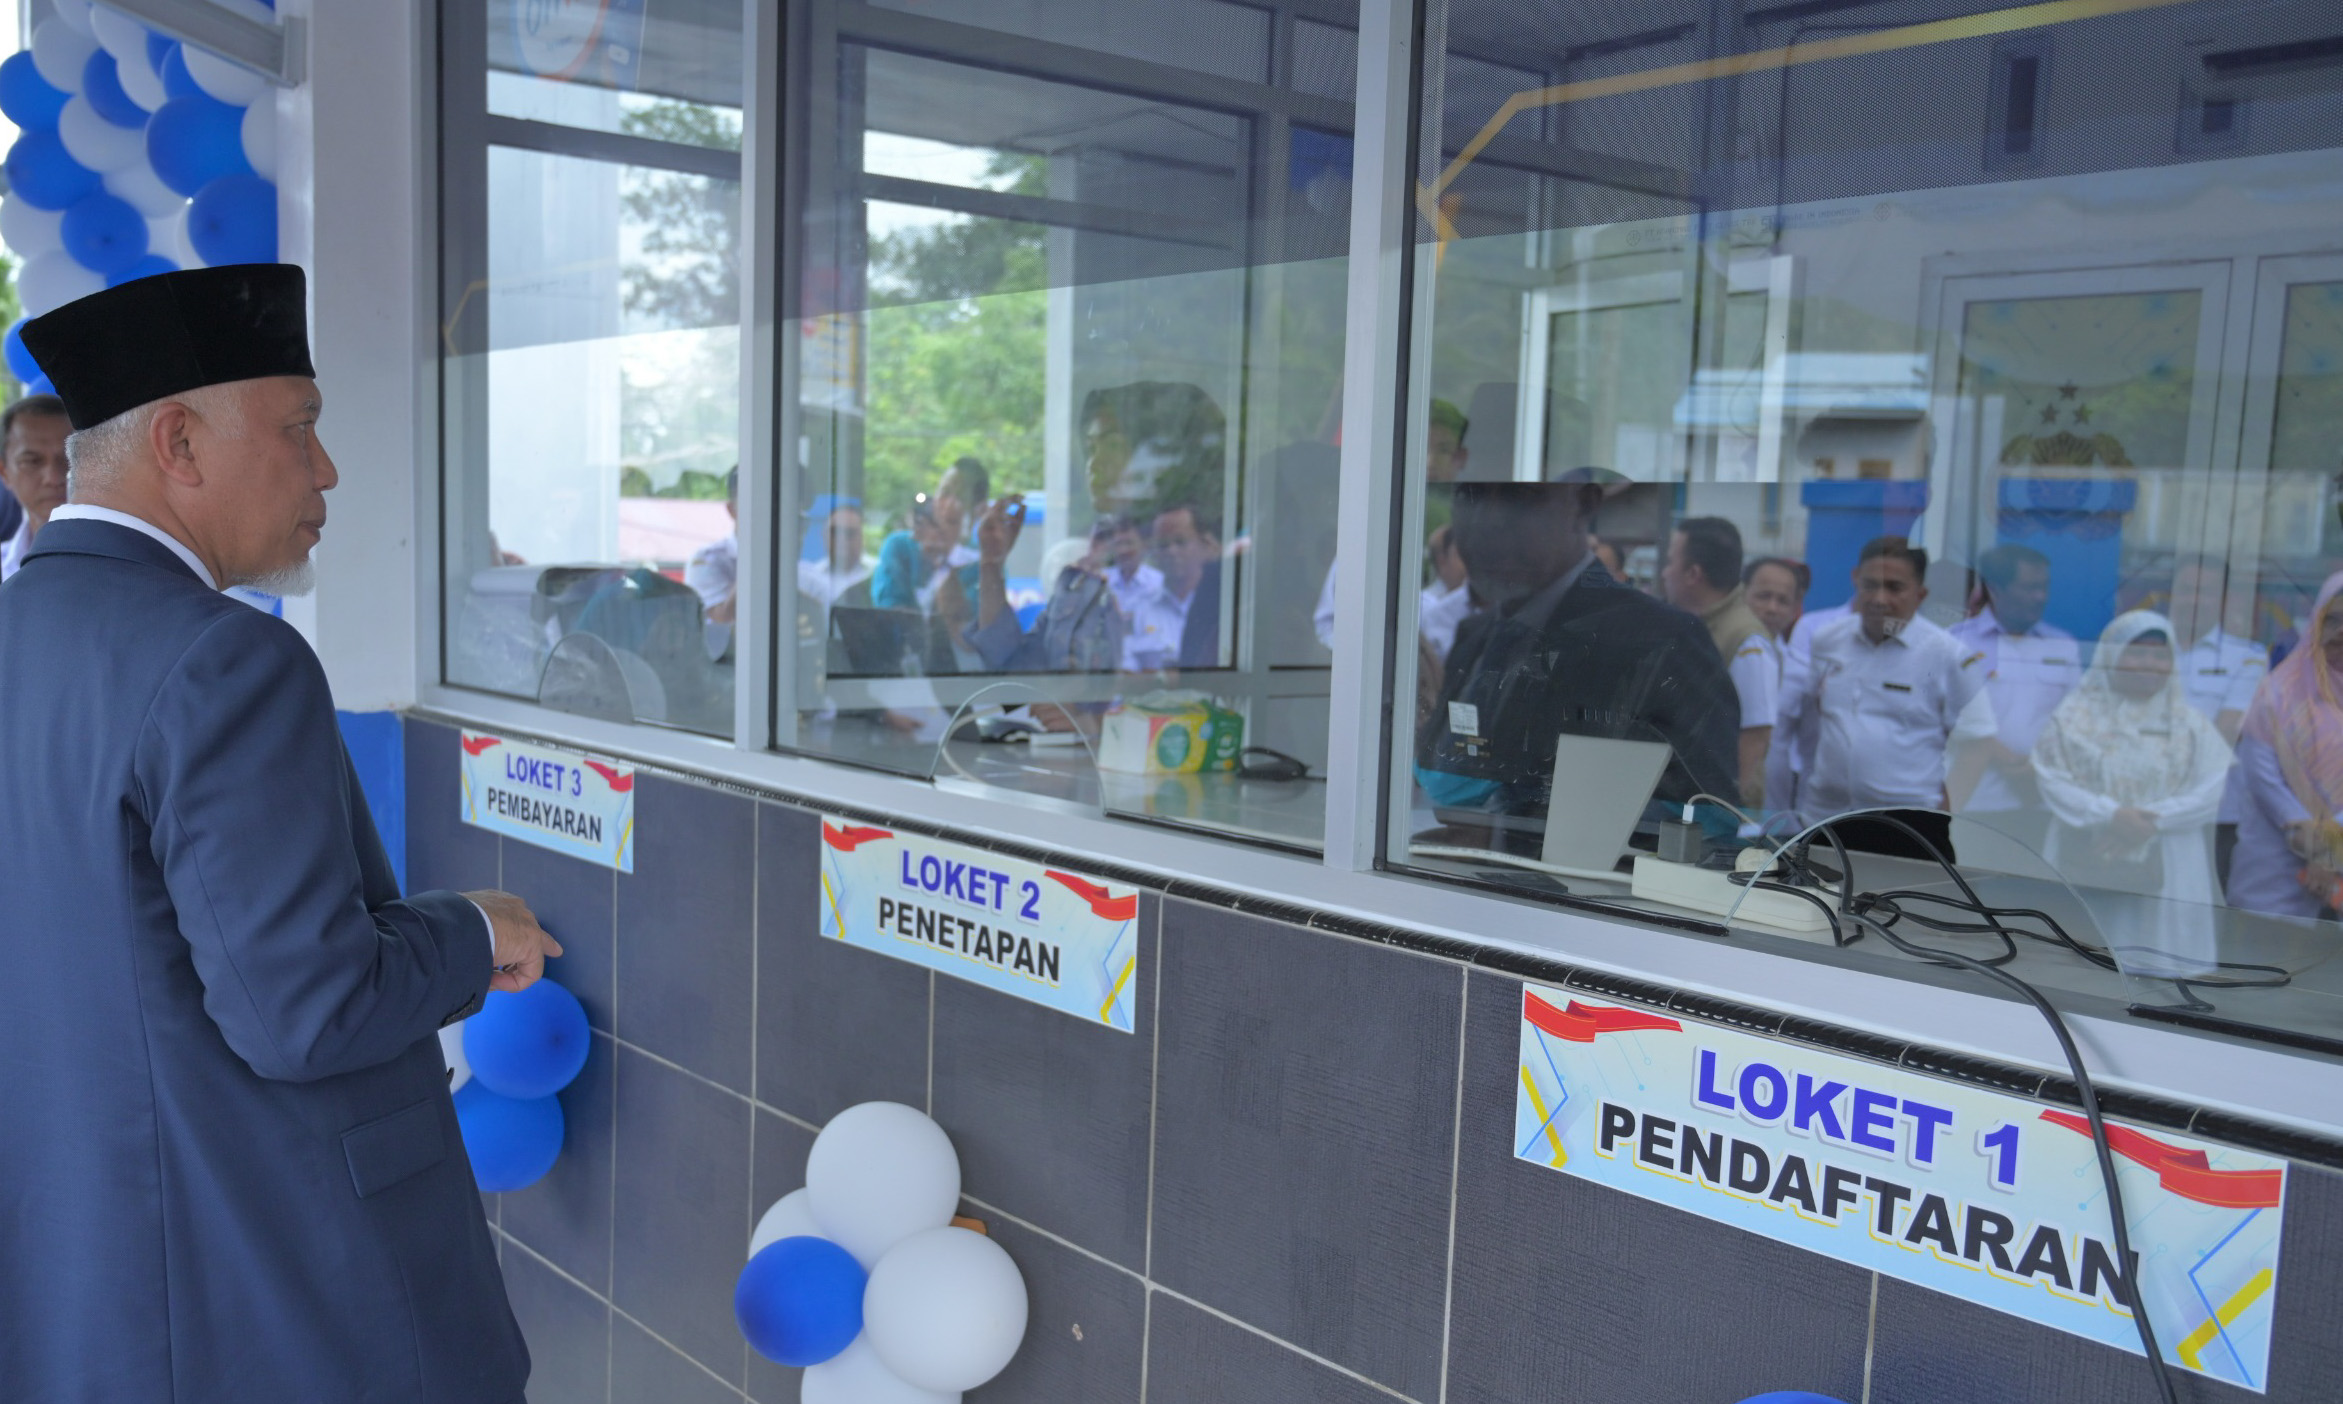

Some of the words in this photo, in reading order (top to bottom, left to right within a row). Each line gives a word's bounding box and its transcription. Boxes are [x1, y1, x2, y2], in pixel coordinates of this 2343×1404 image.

[506, 752, 565, 792] LOKET
[570, 768, 583, 797] 3
[487, 787, 602, 842] PEMBAYARAN
[902, 849, 1009, 910] LOKET
[1020, 881, 1041, 921] 2
[879, 897, 1060, 982] PENETAPAN
[1698, 1050, 1953, 1164] LOKET
[1983, 1123, 2020, 1186] 1
[1600, 1102, 2139, 1307] PENDAFTARAN
